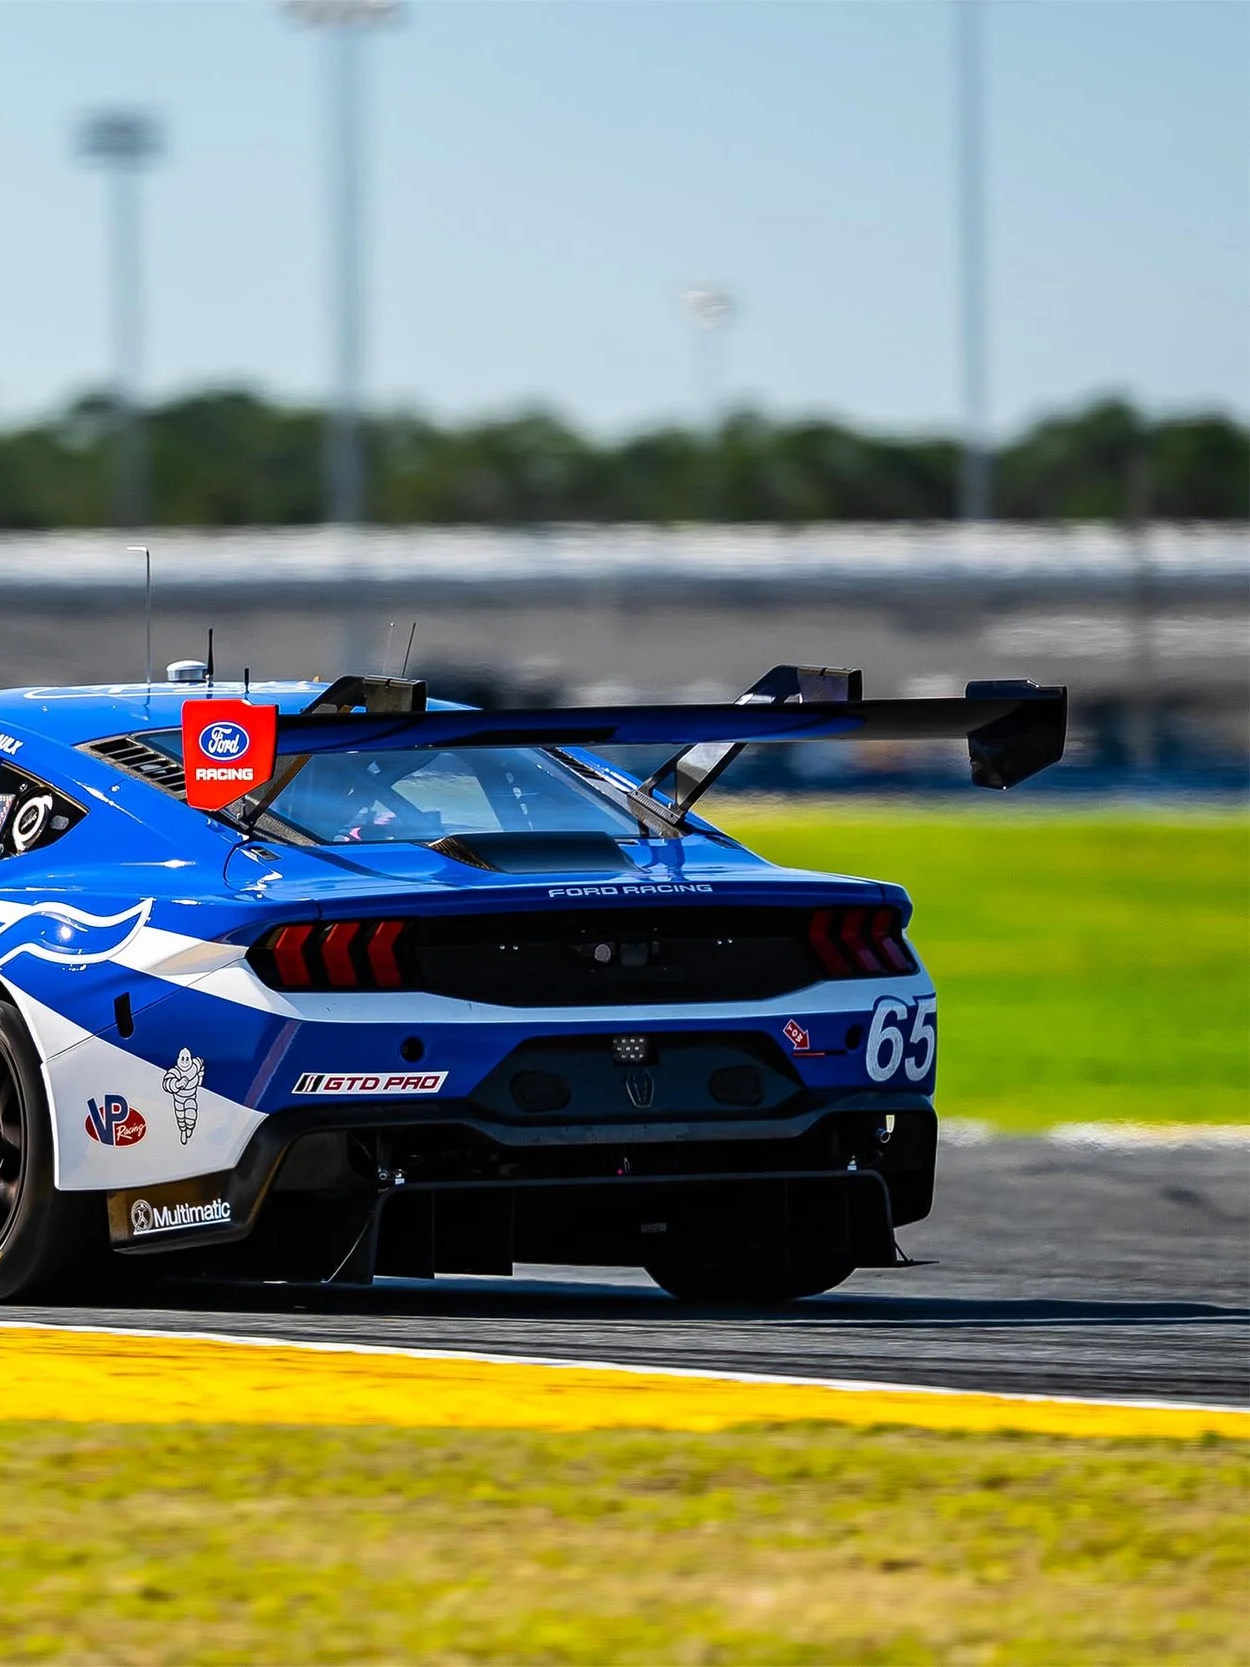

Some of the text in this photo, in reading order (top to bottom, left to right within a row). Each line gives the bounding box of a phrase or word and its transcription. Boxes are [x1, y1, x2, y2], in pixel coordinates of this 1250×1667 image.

[208, 726, 240, 754] Ford
[195, 768, 254, 781] RACING
[548, 883, 714, 898] FORD RACING
[866, 997, 937, 1082] 65
[323, 1075, 442, 1091] GTD PRO
[86, 1093, 130, 1147] VP
[115, 1122, 148, 1142] Racing
[152, 1198, 231, 1228] Multimatic
